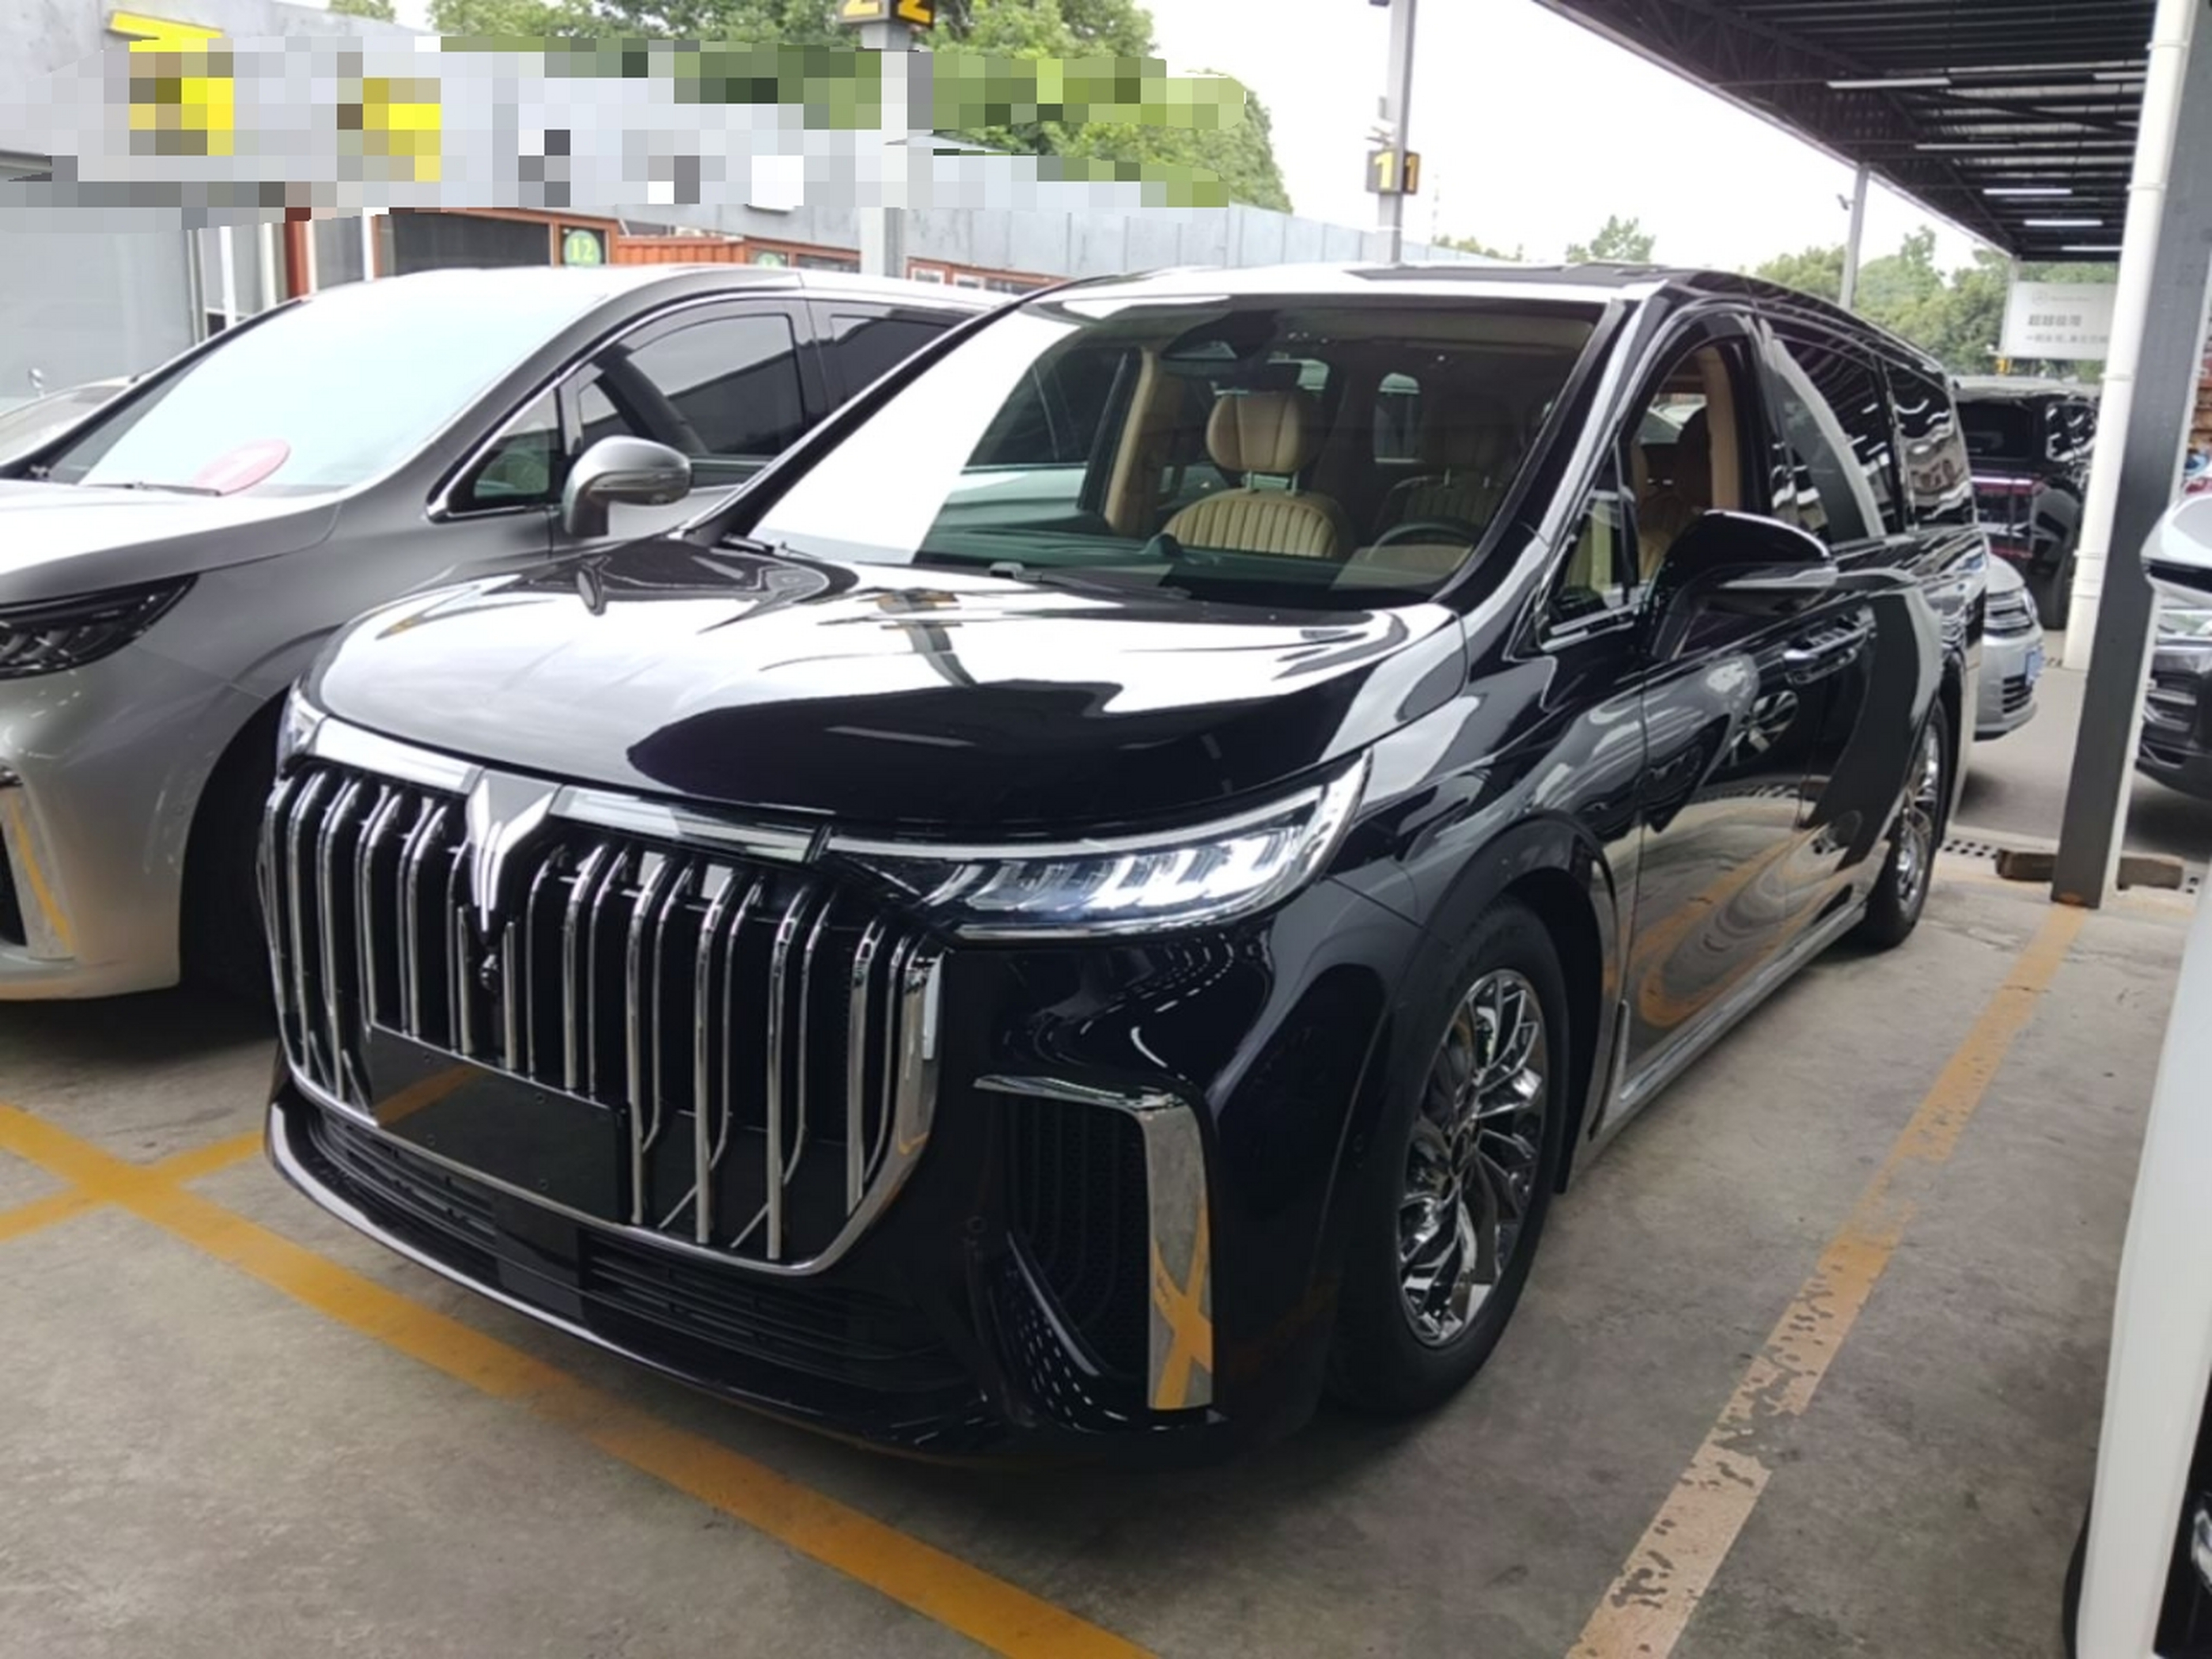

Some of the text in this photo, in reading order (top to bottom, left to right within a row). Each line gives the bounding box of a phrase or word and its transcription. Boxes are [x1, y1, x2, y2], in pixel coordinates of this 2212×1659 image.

[1374, 151, 1393, 188] 1
[1406, 154, 1418, 191] 1
[571, 238, 594, 262] 12
